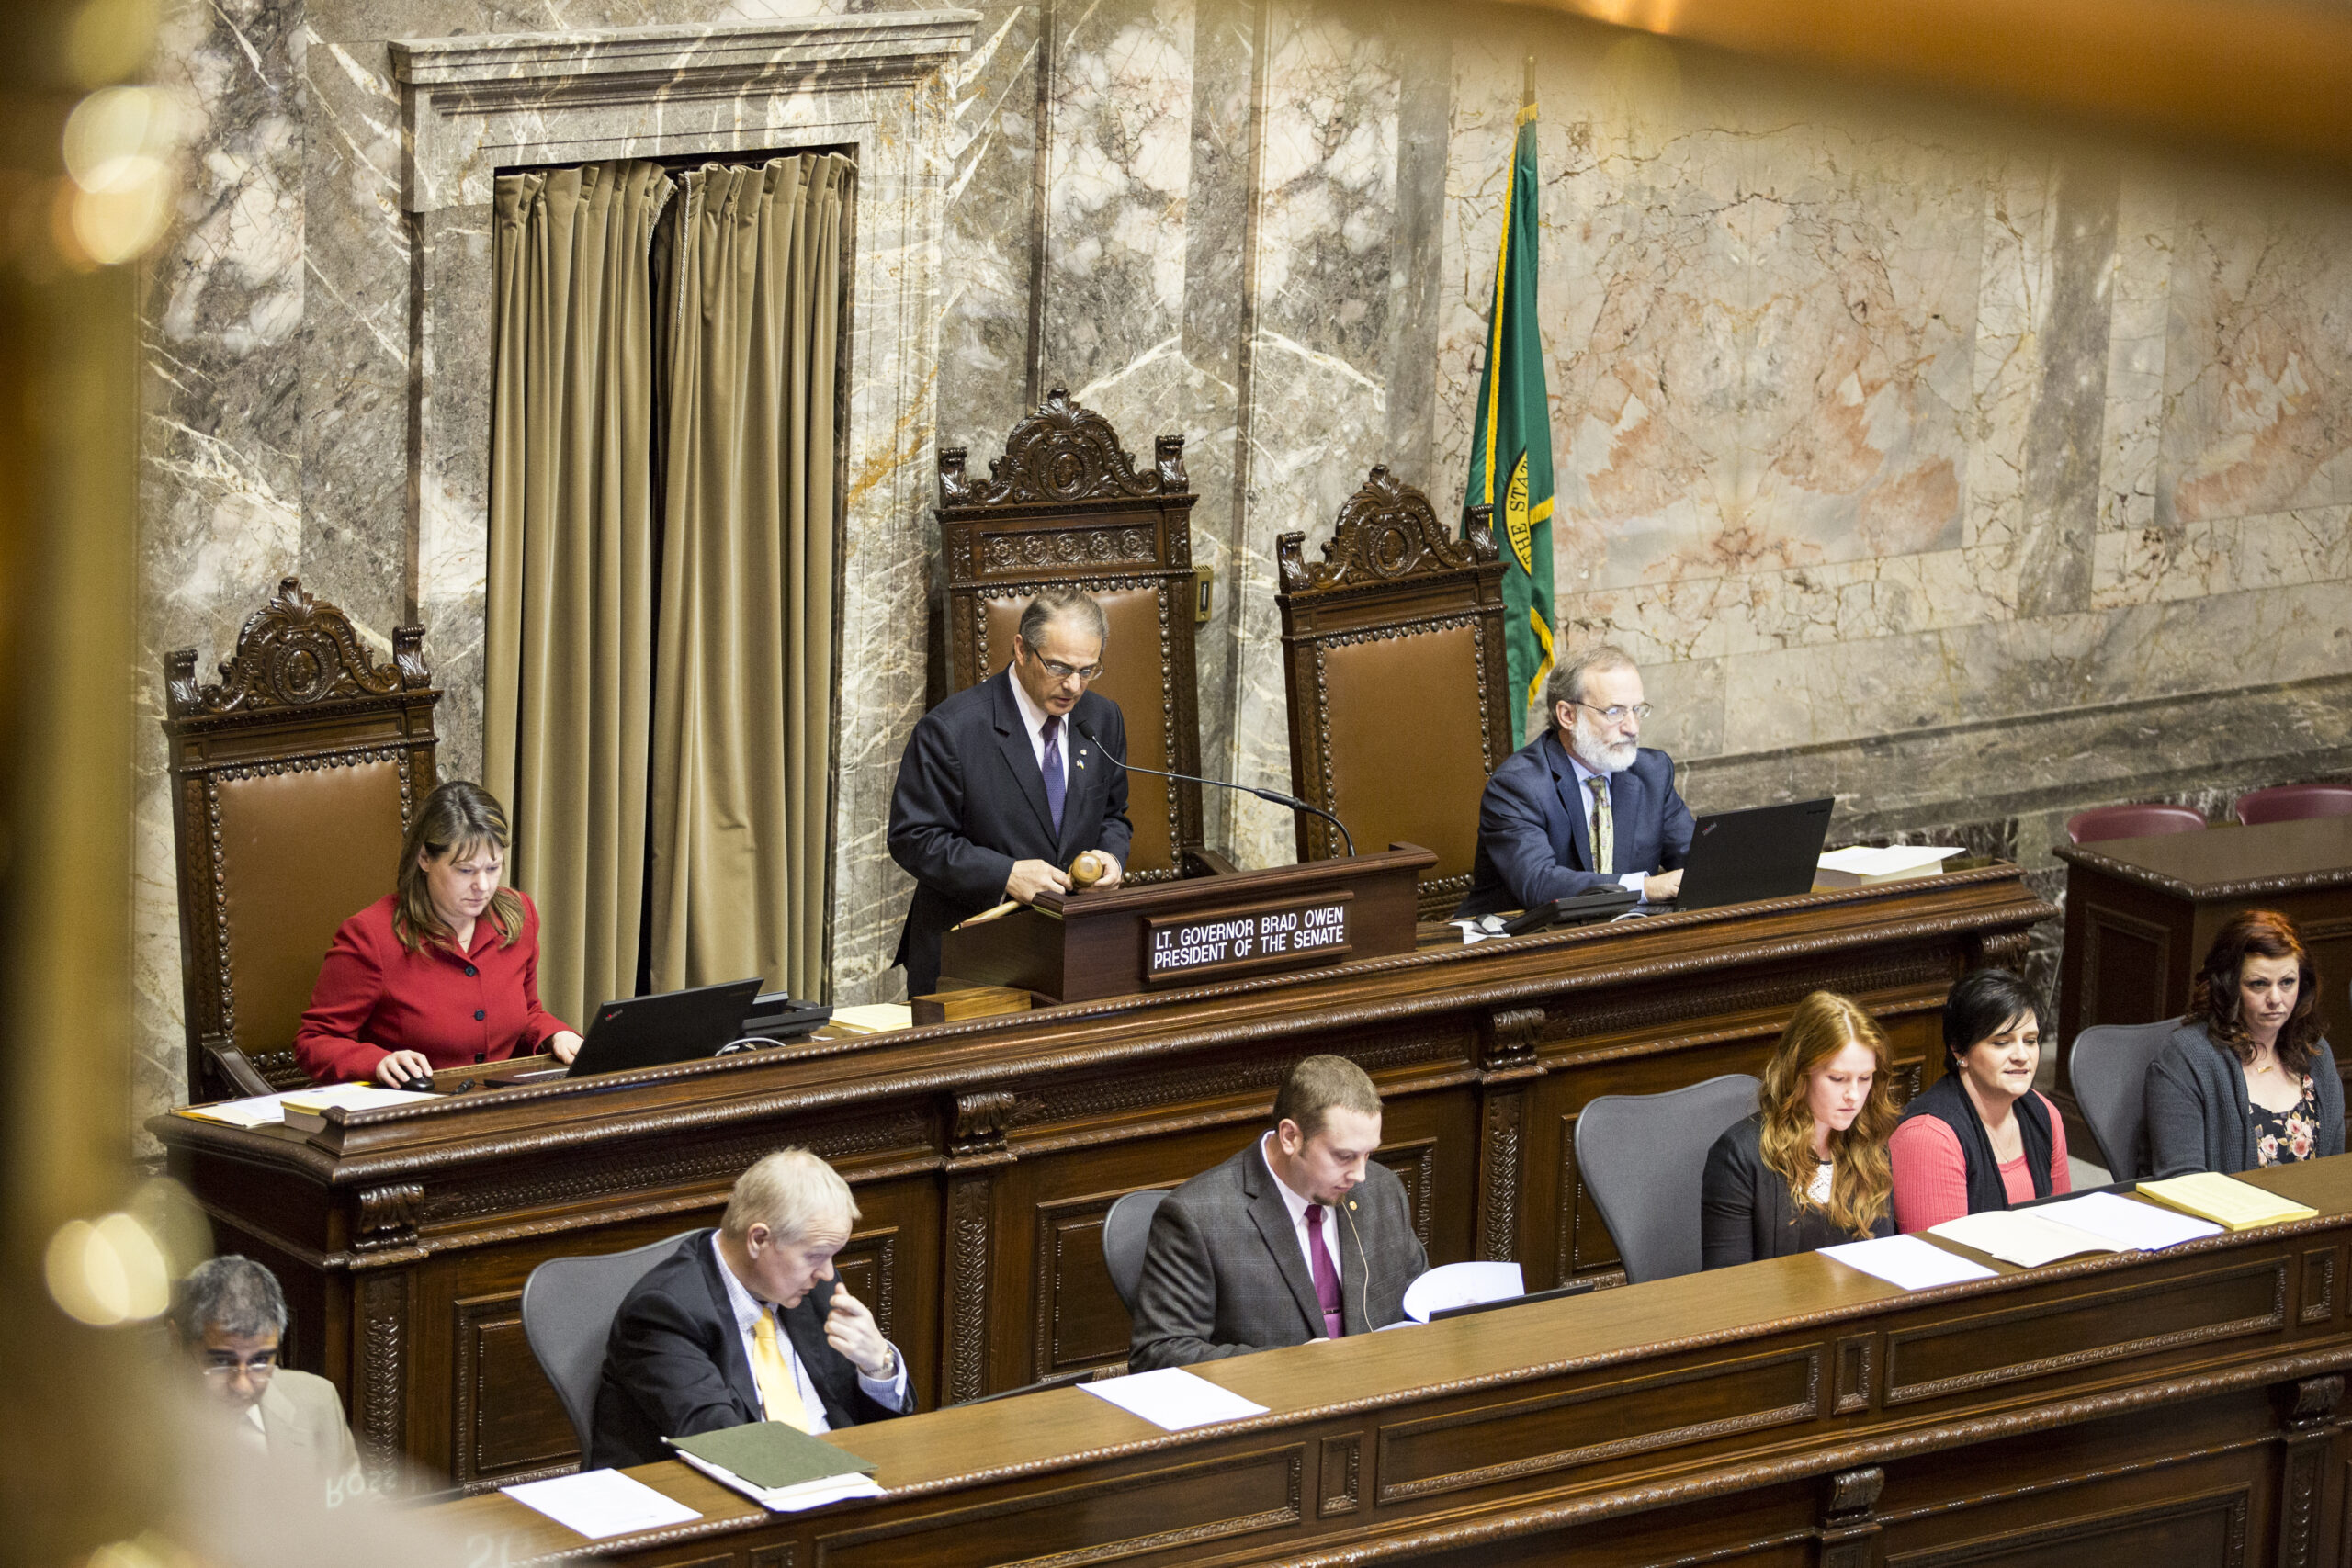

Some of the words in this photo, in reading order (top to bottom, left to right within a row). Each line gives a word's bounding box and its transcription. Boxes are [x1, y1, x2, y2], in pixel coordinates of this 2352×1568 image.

[1511, 523, 1532, 564] THE
[1154, 942, 1227, 969] PRESIDENT
[1234, 938, 1252, 957] OF
[1261, 933, 1286, 954] THE
[1294, 925, 1343, 949] SENATE
[1156, 931, 1172, 950] LT.
[1181, 919, 1254, 946] GOVERNOR
[1261, 913, 1297, 934] BRAD
[1305, 906, 1343, 928] OWEN
